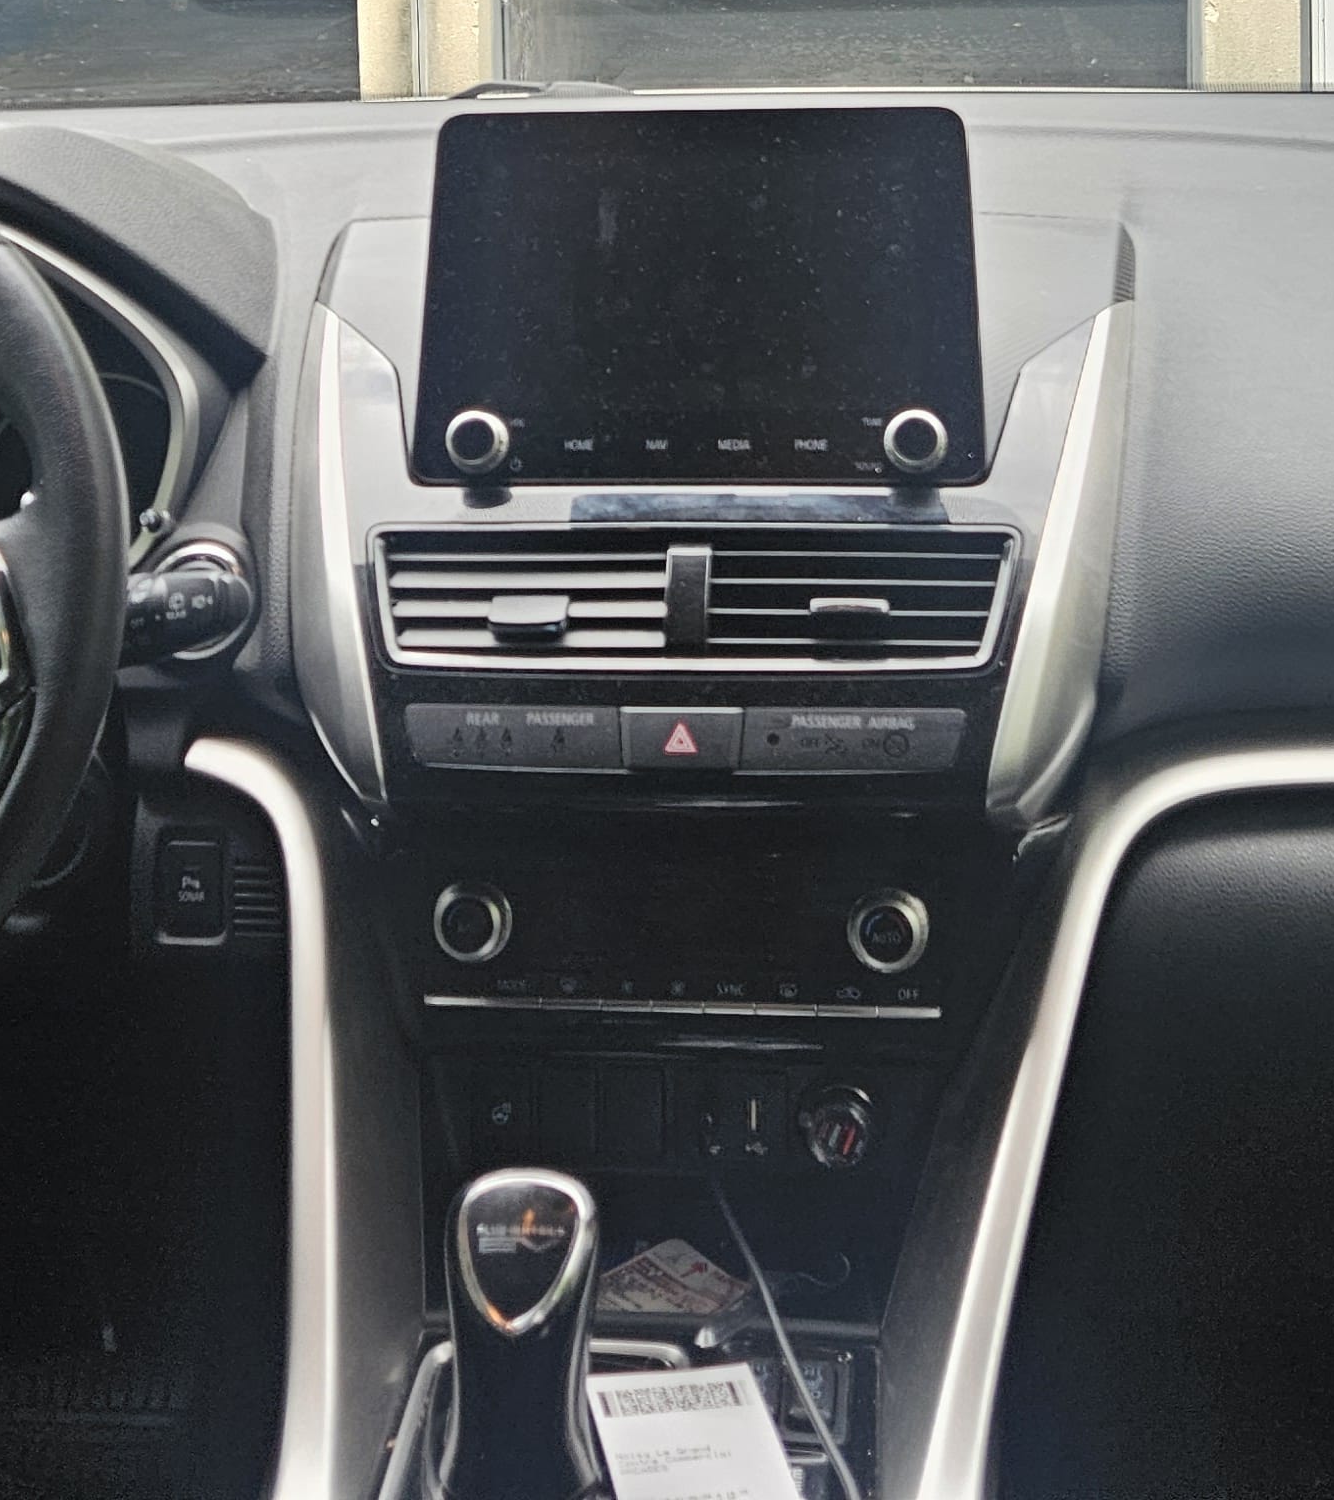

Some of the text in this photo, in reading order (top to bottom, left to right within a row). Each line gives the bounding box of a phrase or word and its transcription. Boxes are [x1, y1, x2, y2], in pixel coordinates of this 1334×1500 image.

[564, 438, 594, 451] HOME
[717, 439, 752, 451] MEDIA
[794, 439, 829, 451] PHONE
[466, 712, 500, 726] REAR
[526, 712, 595, 726] PASSENGER
[790, 715, 915, 731] PASSENGER AIRBAG
[898, 988, 920, 1000] OFF
